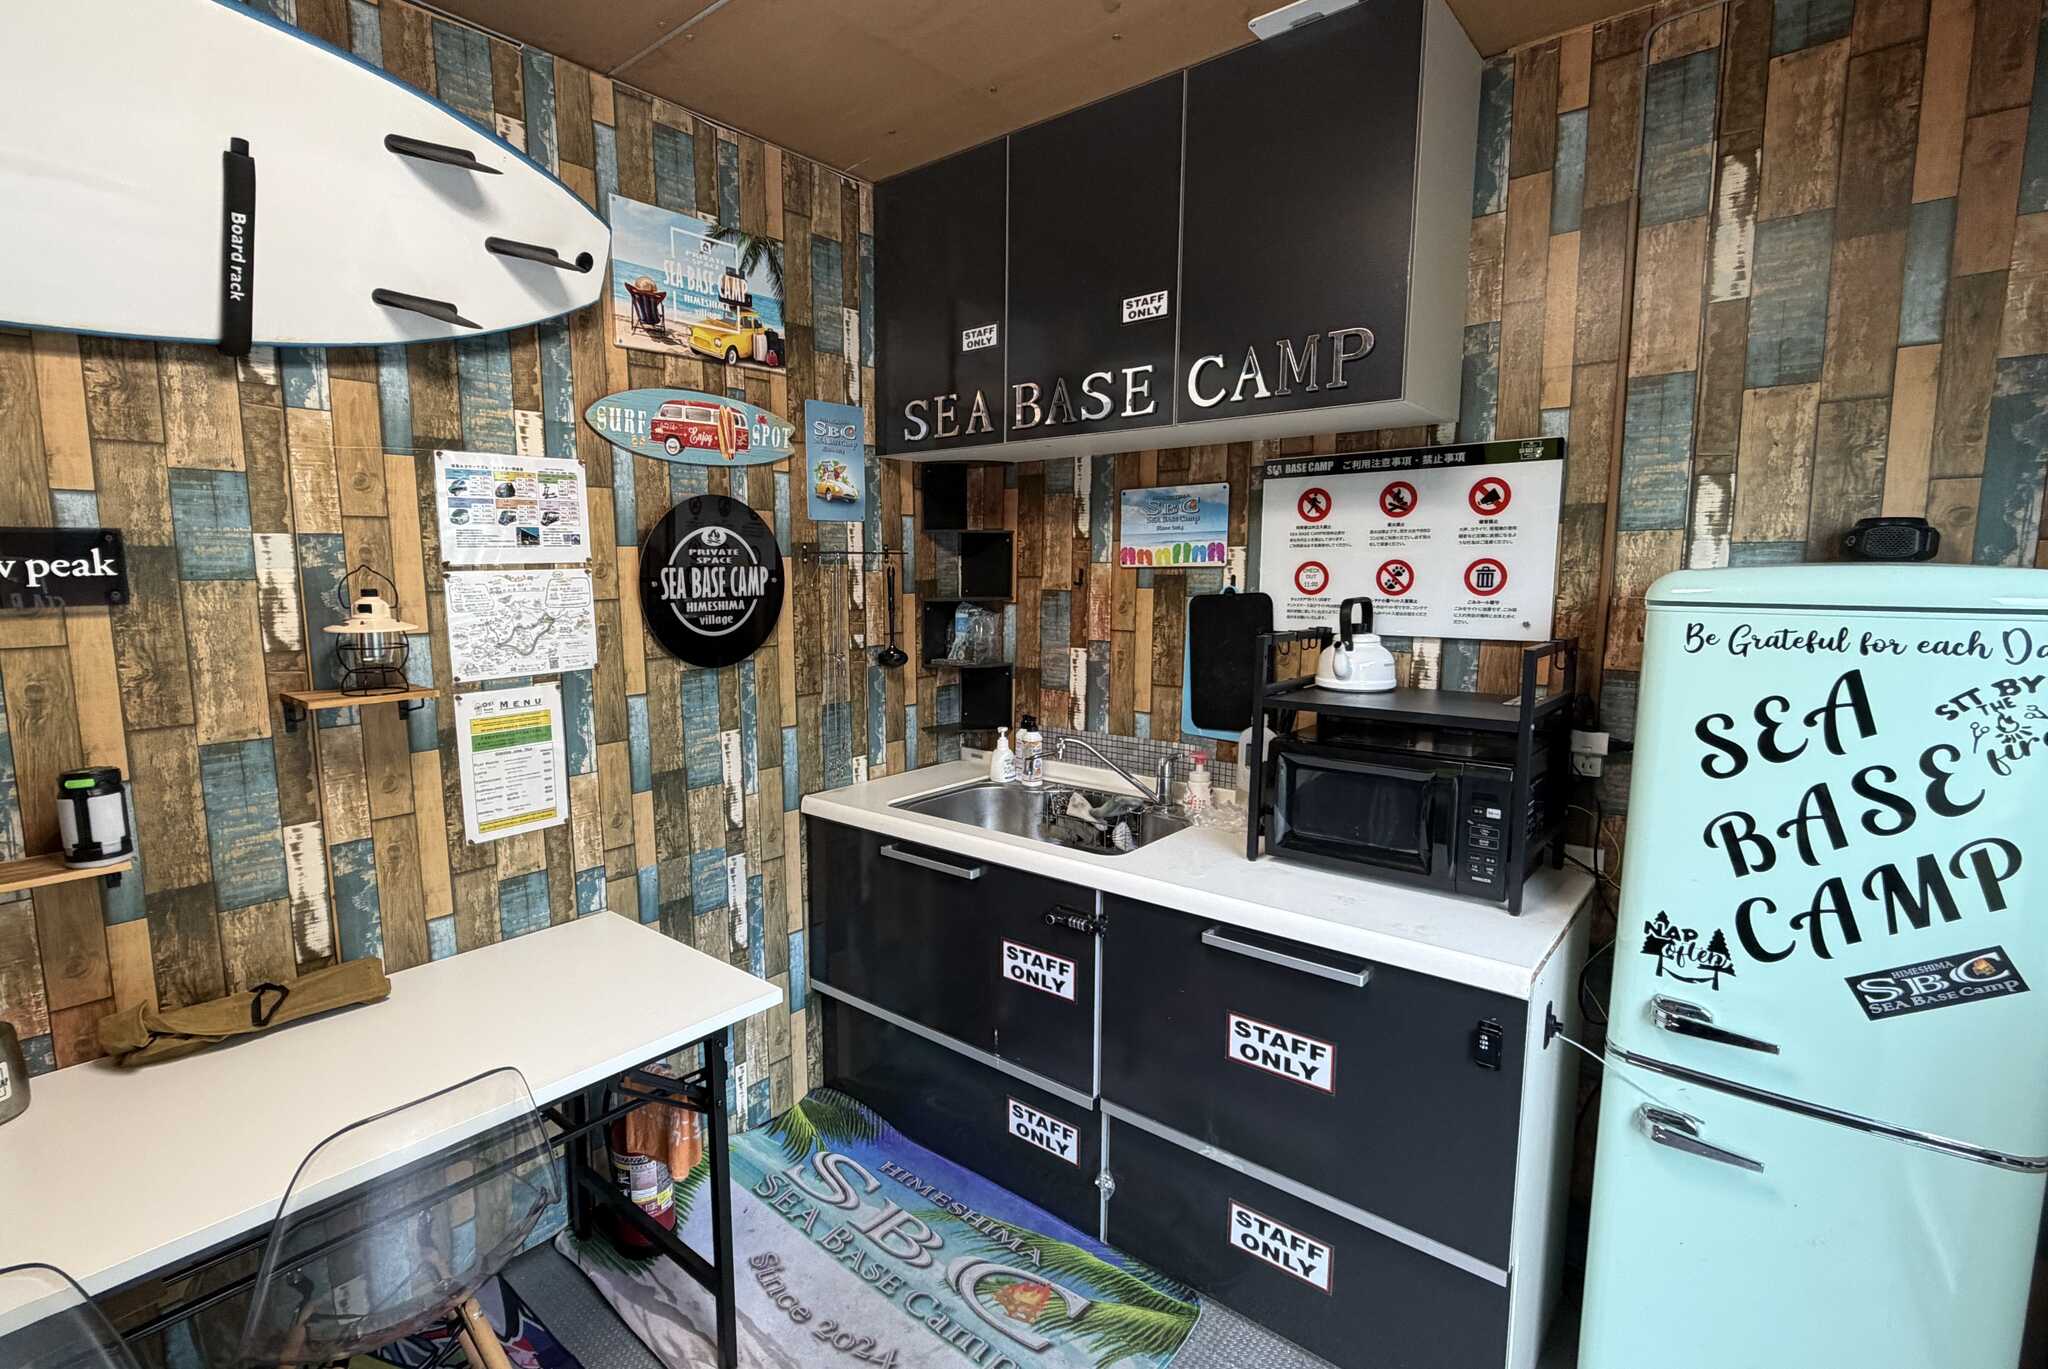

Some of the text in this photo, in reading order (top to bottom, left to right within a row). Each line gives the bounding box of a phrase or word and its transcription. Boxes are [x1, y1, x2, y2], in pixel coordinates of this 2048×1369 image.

[230, 211, 247, 301] Board rack
[663, 259, 749, 303] SEA BASE CAMP
[1126, 293, 1165, 310] STAFF
[1128, 305, 1162, 319] ONLY
[964, 326, 995, 340] STAFF
[967, 336, 993, 348] ONLY
[904, 327, 1375, 442] SEA BASE CAMP
[596, 406, 647, 434] SURF
[752, 424, 793, 449] SPOT
[688, 427, 713, 446] Enjoy
[1266, 461, 1334, 475] SEA BASE CAMP
[25, 547, 119, 588] peak
[689, 548, 740, 556] PRIVATE
[696, 556, 733, 564] SPACE
[660, 566, 769, 600] SEA BASE CAMP
[686, 600, 745, 613] HIMESHIMA
[699, 614, 734, 626] village
[1684, 622, 1720, 653] Be
[1727, 623, 1851, 657] Grateful
[1859, 631, 1908, 656] for
[1917, 630, 1993, 660] each
[499, 698, 542, 709] MENU
[1935, 674, 2046, 721] SIT BY
[1976, 697, 2017, 716] THE
[1695, 669, 1878, 779] SEA
[1986, 731, 2048, 776] fir
[1703, 743, 1986, 878] BASE
[1735, 837, 2022, 962] CAMP
[1644, 920, 1699, 942] NAP
[1006, 945, 1071, 977] STAFF
[1664, 941, 1727, 968] often
[1891, 960, 1955, 979] HIMESHIMA
[1010, 964, 1066, 994] ONLY
[1856, 951, 2011, 1003] SBC
[1868, 980, 2020, 1014] SEA BASE Camp
[1234, 1020, 1327, 1061] STAFF
[1239, 1042, 1320, 1082] ONLY
[1012, 1104, 1074, 1142] STAFF
[1016, 1122, 1070, 1157] ONLY
[879, 1160, 1042, 1267] HIMESHIMA
[783, 1151, 1092, 1353] SBC
[1235, 1209, 1326, 1261] STAFF
[752, 1172, 821, 1236] SEA
[818, 1224, 906, 1297] BASE
[903, 1290, 1021, 1369] Camp
[1240, 1233, 1317, 1279] ONLY
[750, 1251, 899, 1369] Since 2024
